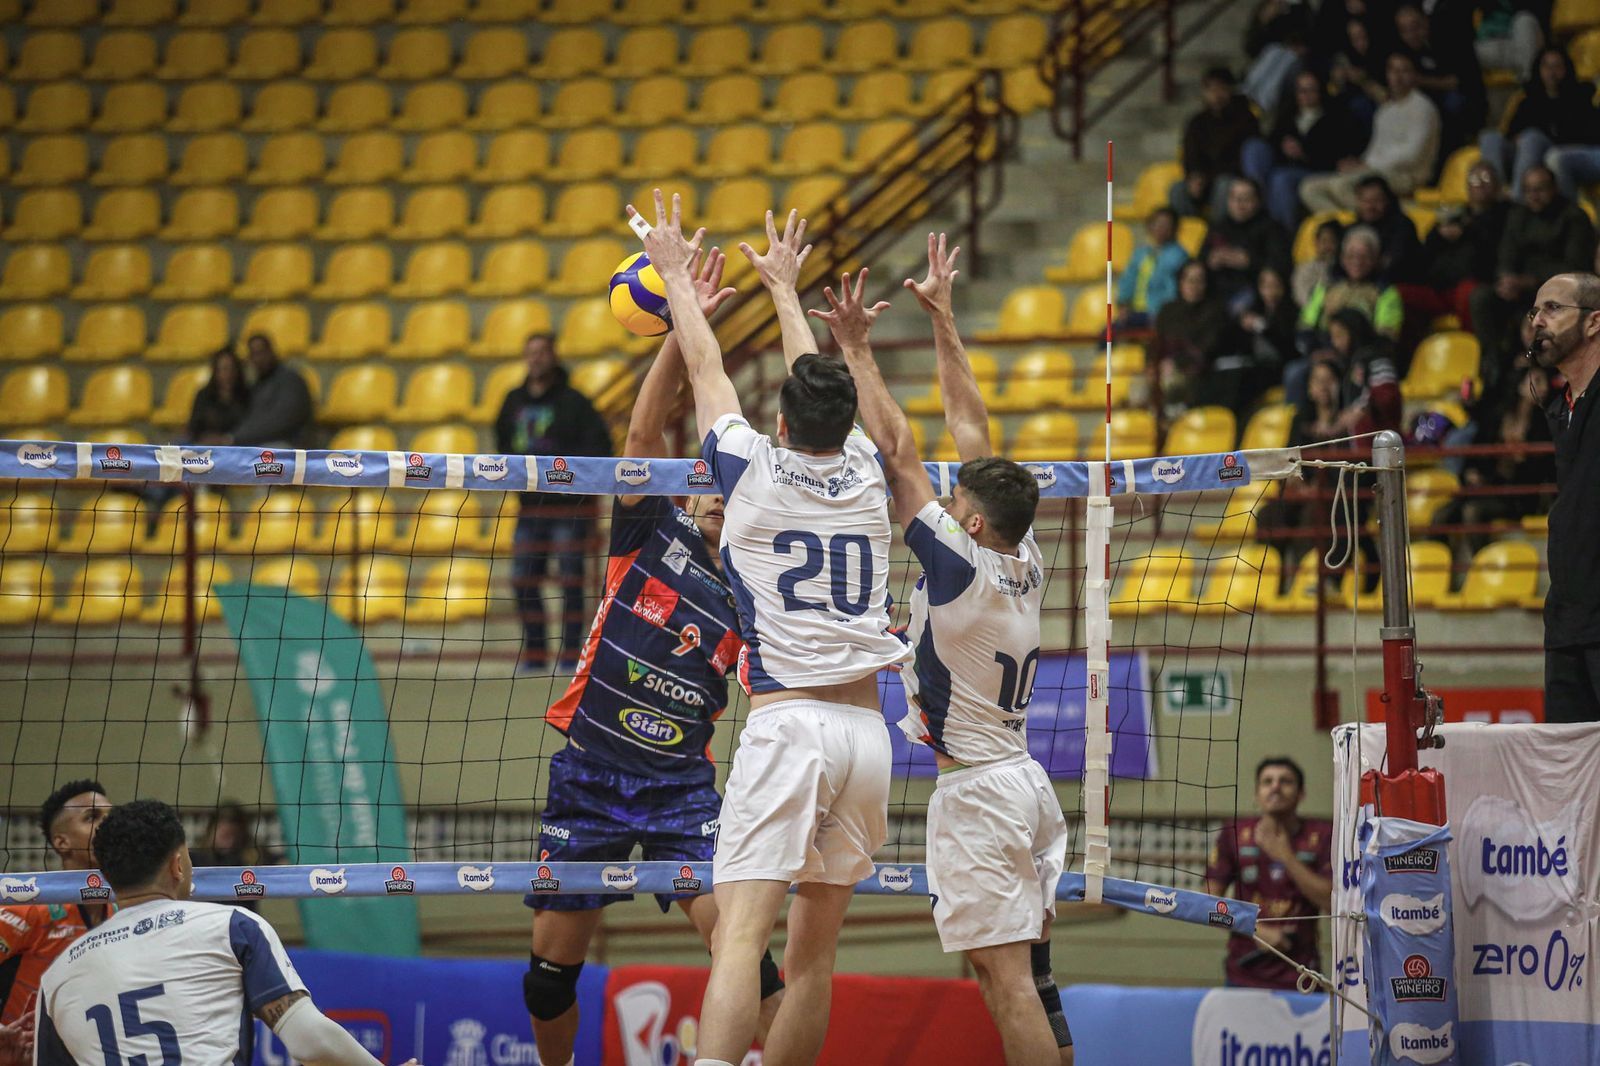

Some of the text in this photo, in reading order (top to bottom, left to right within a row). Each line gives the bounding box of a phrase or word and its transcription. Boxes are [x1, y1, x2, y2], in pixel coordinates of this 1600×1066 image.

[332, 460, 358, 469] itambé
[479, 461, 504, 472] itambé
[621, 466, 646, 477] itambé
[1158, 466, 1181, 476] itambé
[772, 529, 873, 616] 20
[671, 623, 701, 656] 9
[995, 647, 1040, 713] 10
[629, 712, 674, 740] Start
[542, 824, 570, 840] SICOOB
[1388, 855, 1432, 866] MINEIRO
[1482, 835, 1568, 876] també
[316, 876, 342, 885] itambé
[464, 873, 489, 882] itambé
[607, 873, 633, 882] itambé
[884, 874, 909, 883] itambé
[6, 883, 34, 892] itambé
[1391, 904, 1440, 920] itambé
[68, 933, 129, 964] Juiz de Fora
[69, 926, 129, 956] Prefeitura
[1473, 943, 1539, 976] zero
[1396, 984, 1440, 994] MINEIRO
[85, 983, 183, 1066] 15
[1401, 1033, 1449, 1050] itambé
